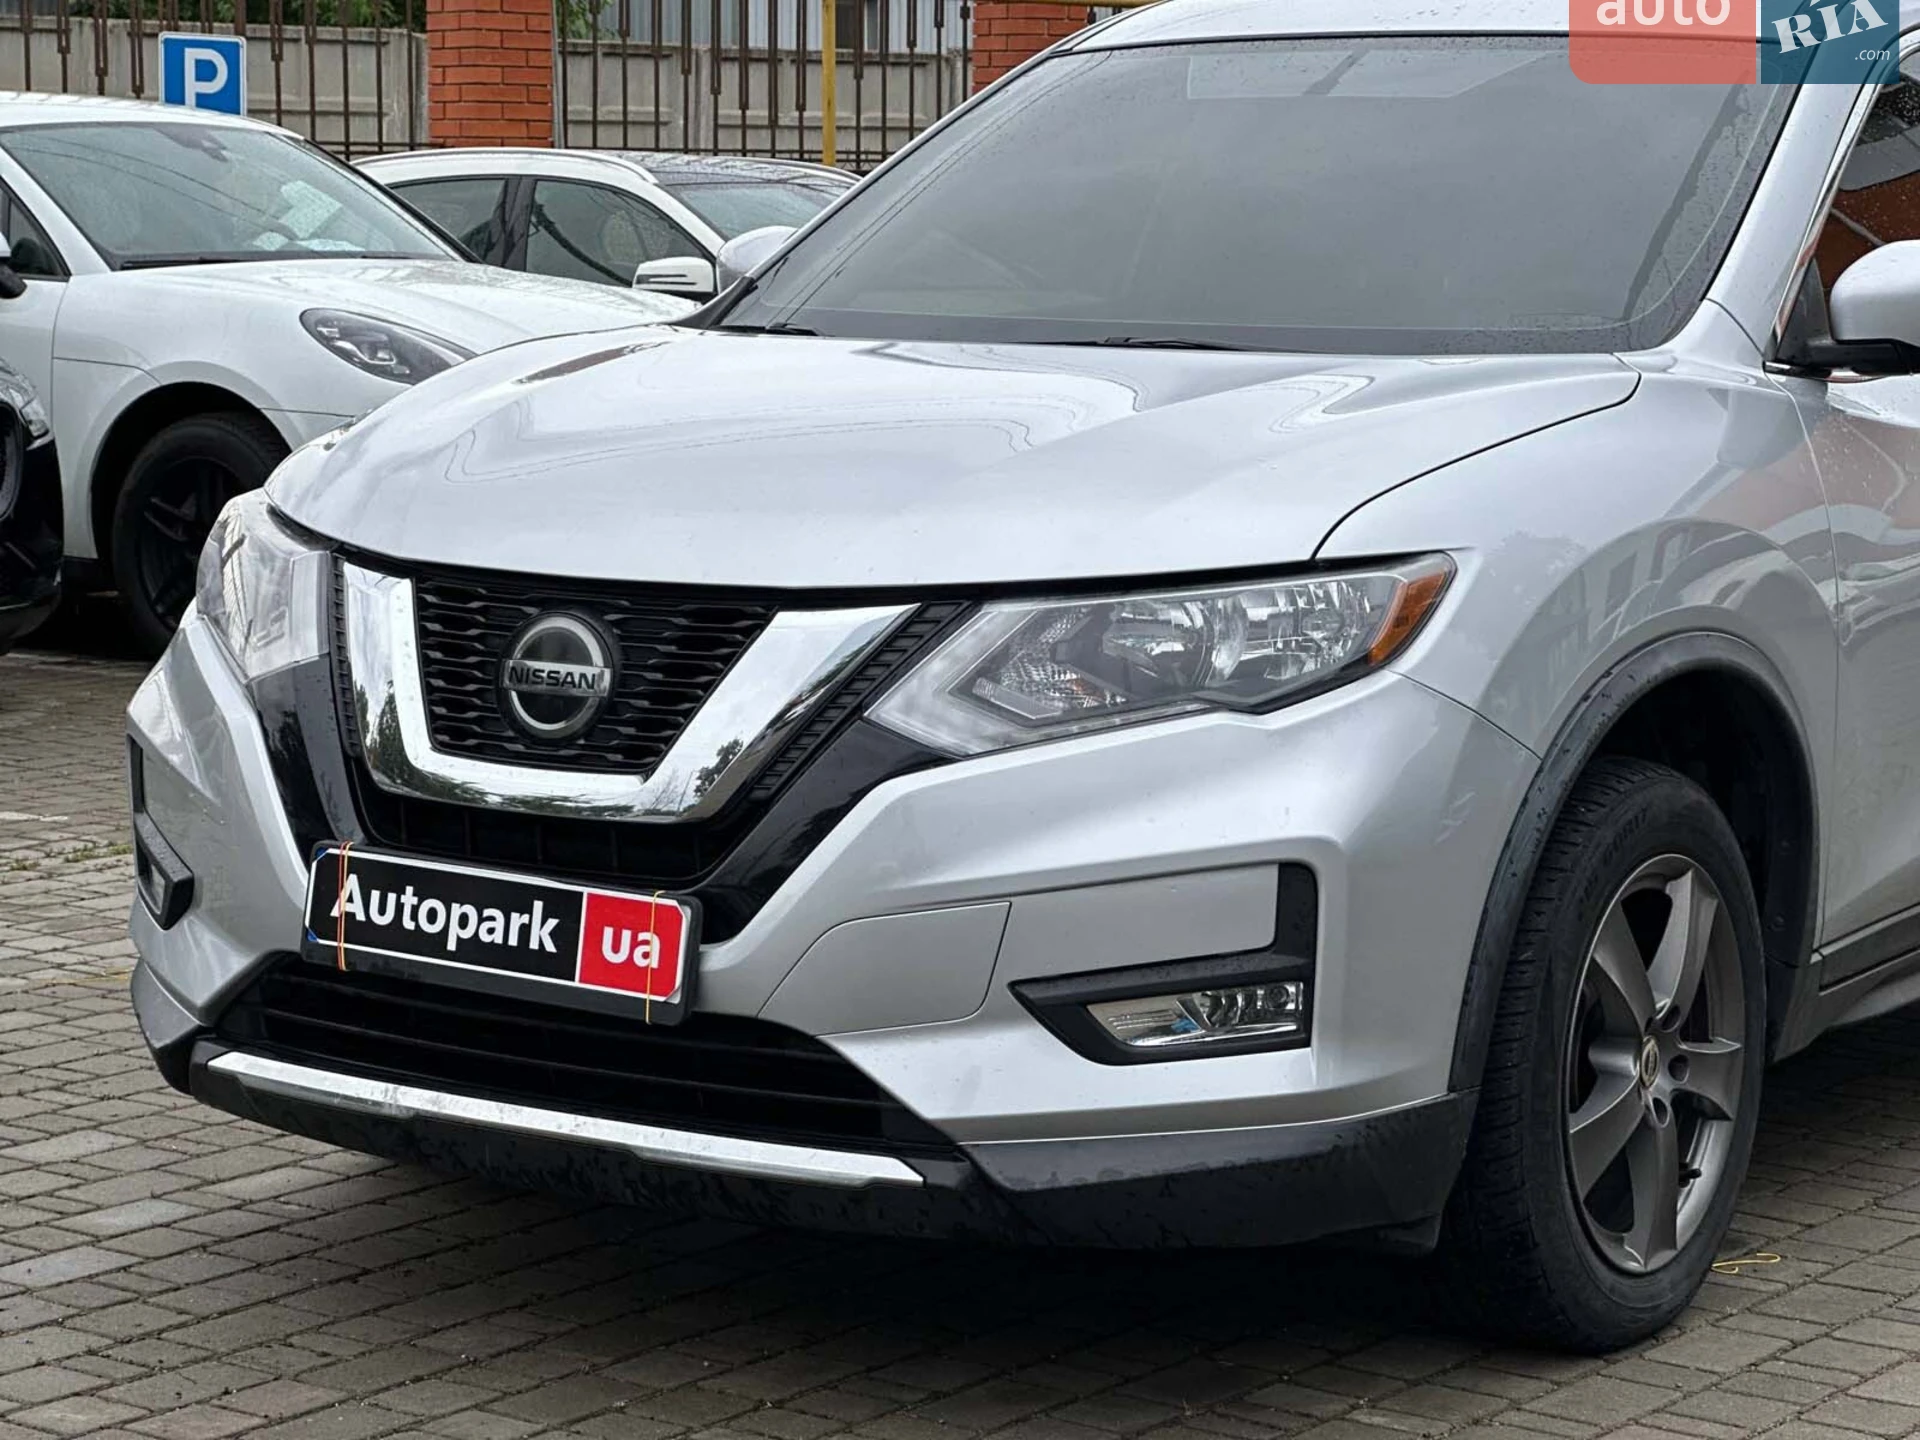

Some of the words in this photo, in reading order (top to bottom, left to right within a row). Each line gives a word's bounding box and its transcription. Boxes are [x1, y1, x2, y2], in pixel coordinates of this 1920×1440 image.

[183, 47, 229, 107] P
[508, 666, 596, 690] NISSAN
[330, 873, 560, 952] Autopark
[600, 926, 662, 969] ua
